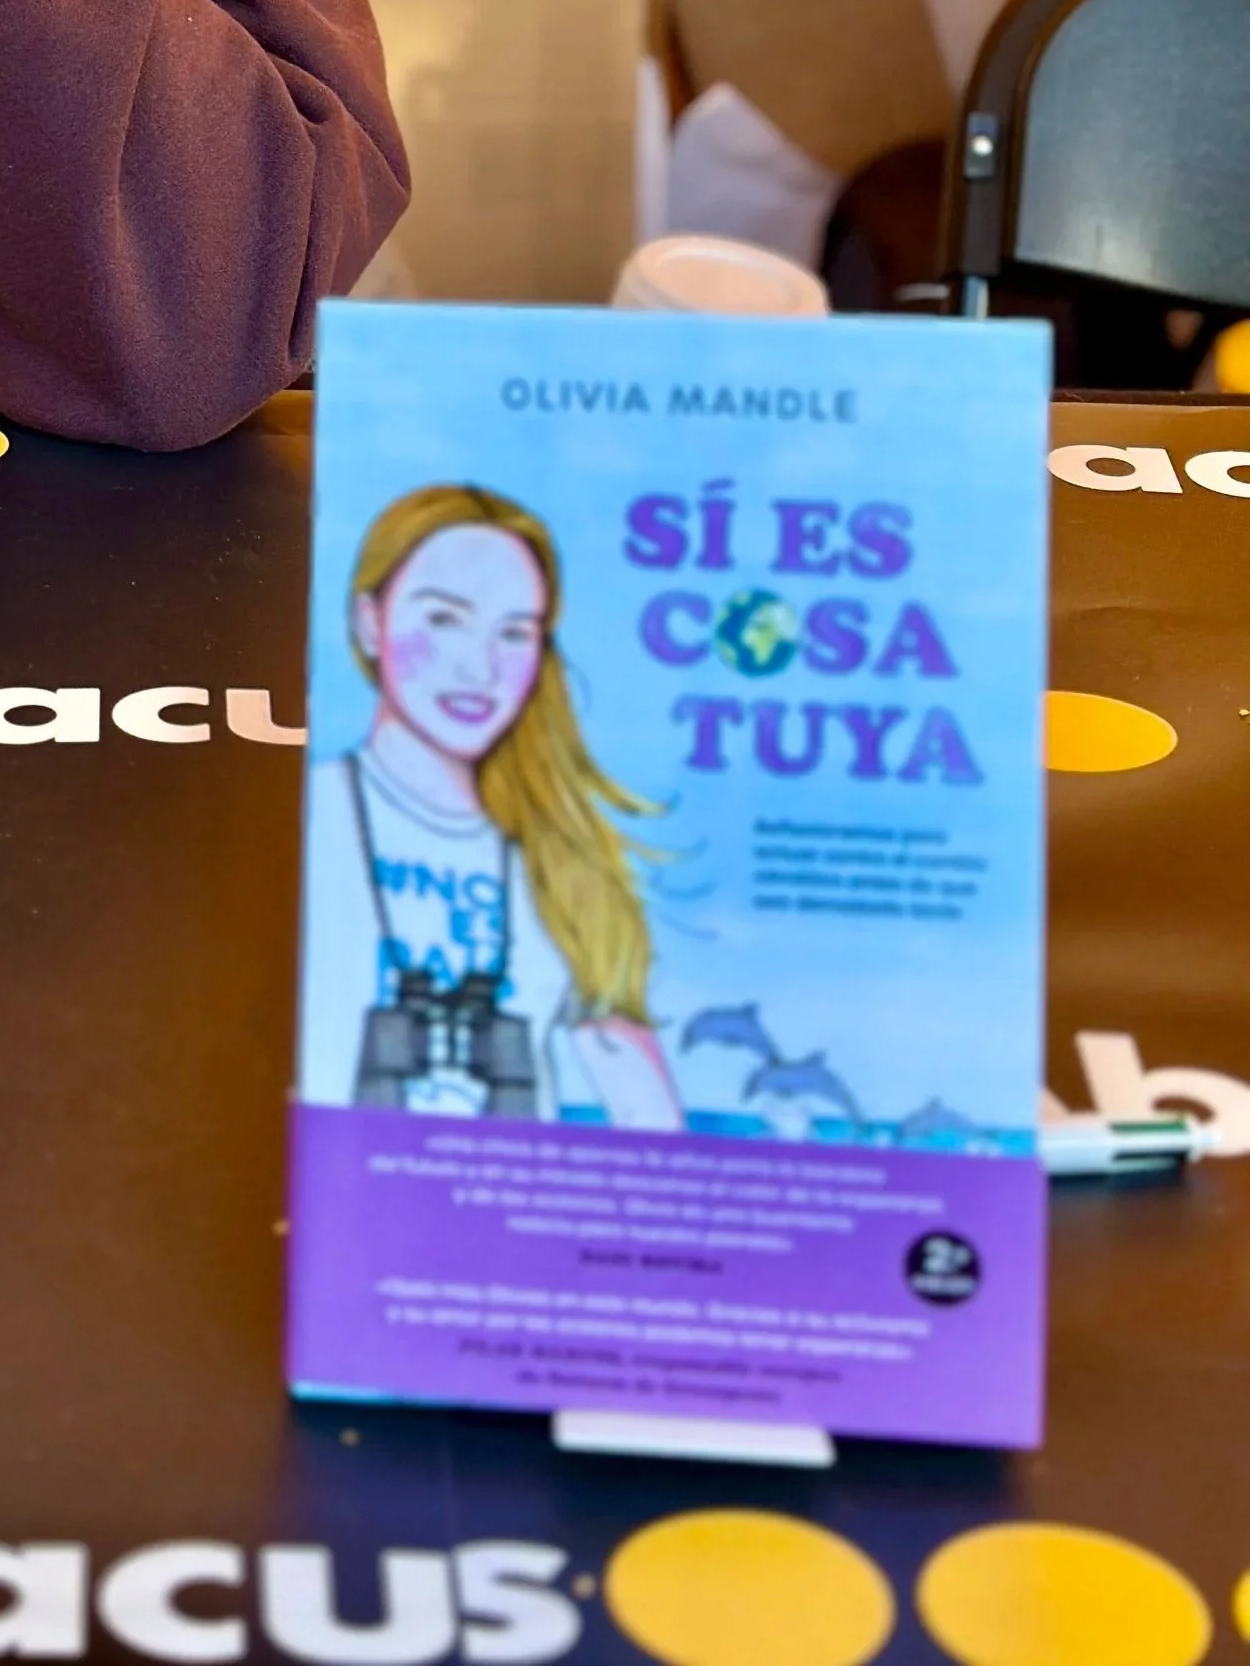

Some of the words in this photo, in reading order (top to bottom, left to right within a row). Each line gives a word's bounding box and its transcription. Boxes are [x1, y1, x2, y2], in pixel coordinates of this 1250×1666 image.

[500, 377, 649, 413] OLIVIA
[667, 383, 856, 423] MANDLE
[624, 478, 737, 572] SÍ
[770, 498, 914, 580] ES
[671, 692, 986, 786] TUYA
